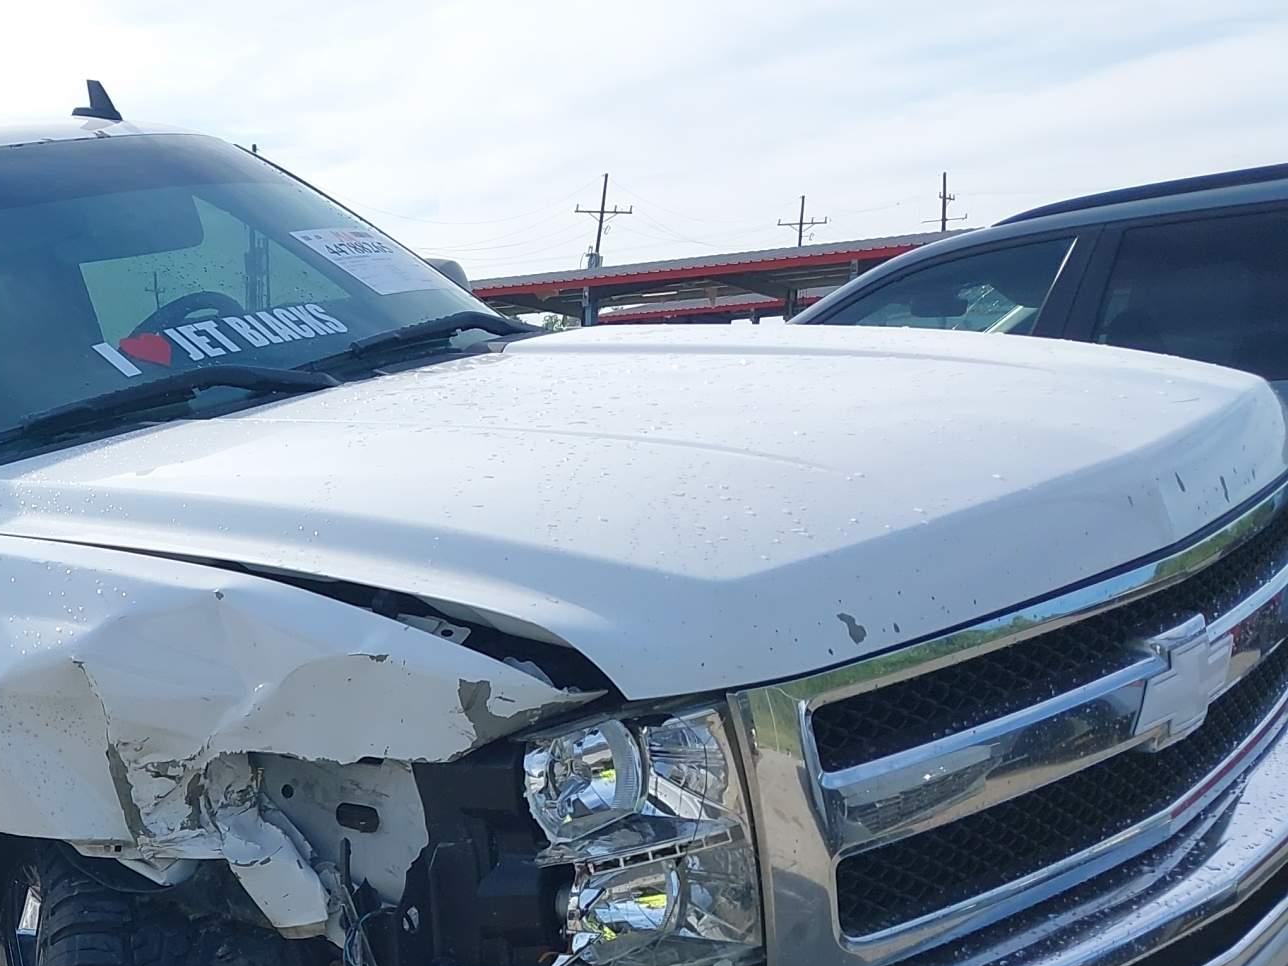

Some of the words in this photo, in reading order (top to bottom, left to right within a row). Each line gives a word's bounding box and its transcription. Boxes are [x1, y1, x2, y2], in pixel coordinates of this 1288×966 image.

[91, 342, 143, 378] I
[163, 319, 243, 362] JET
[222, 302, 349, 348] BLACKS
